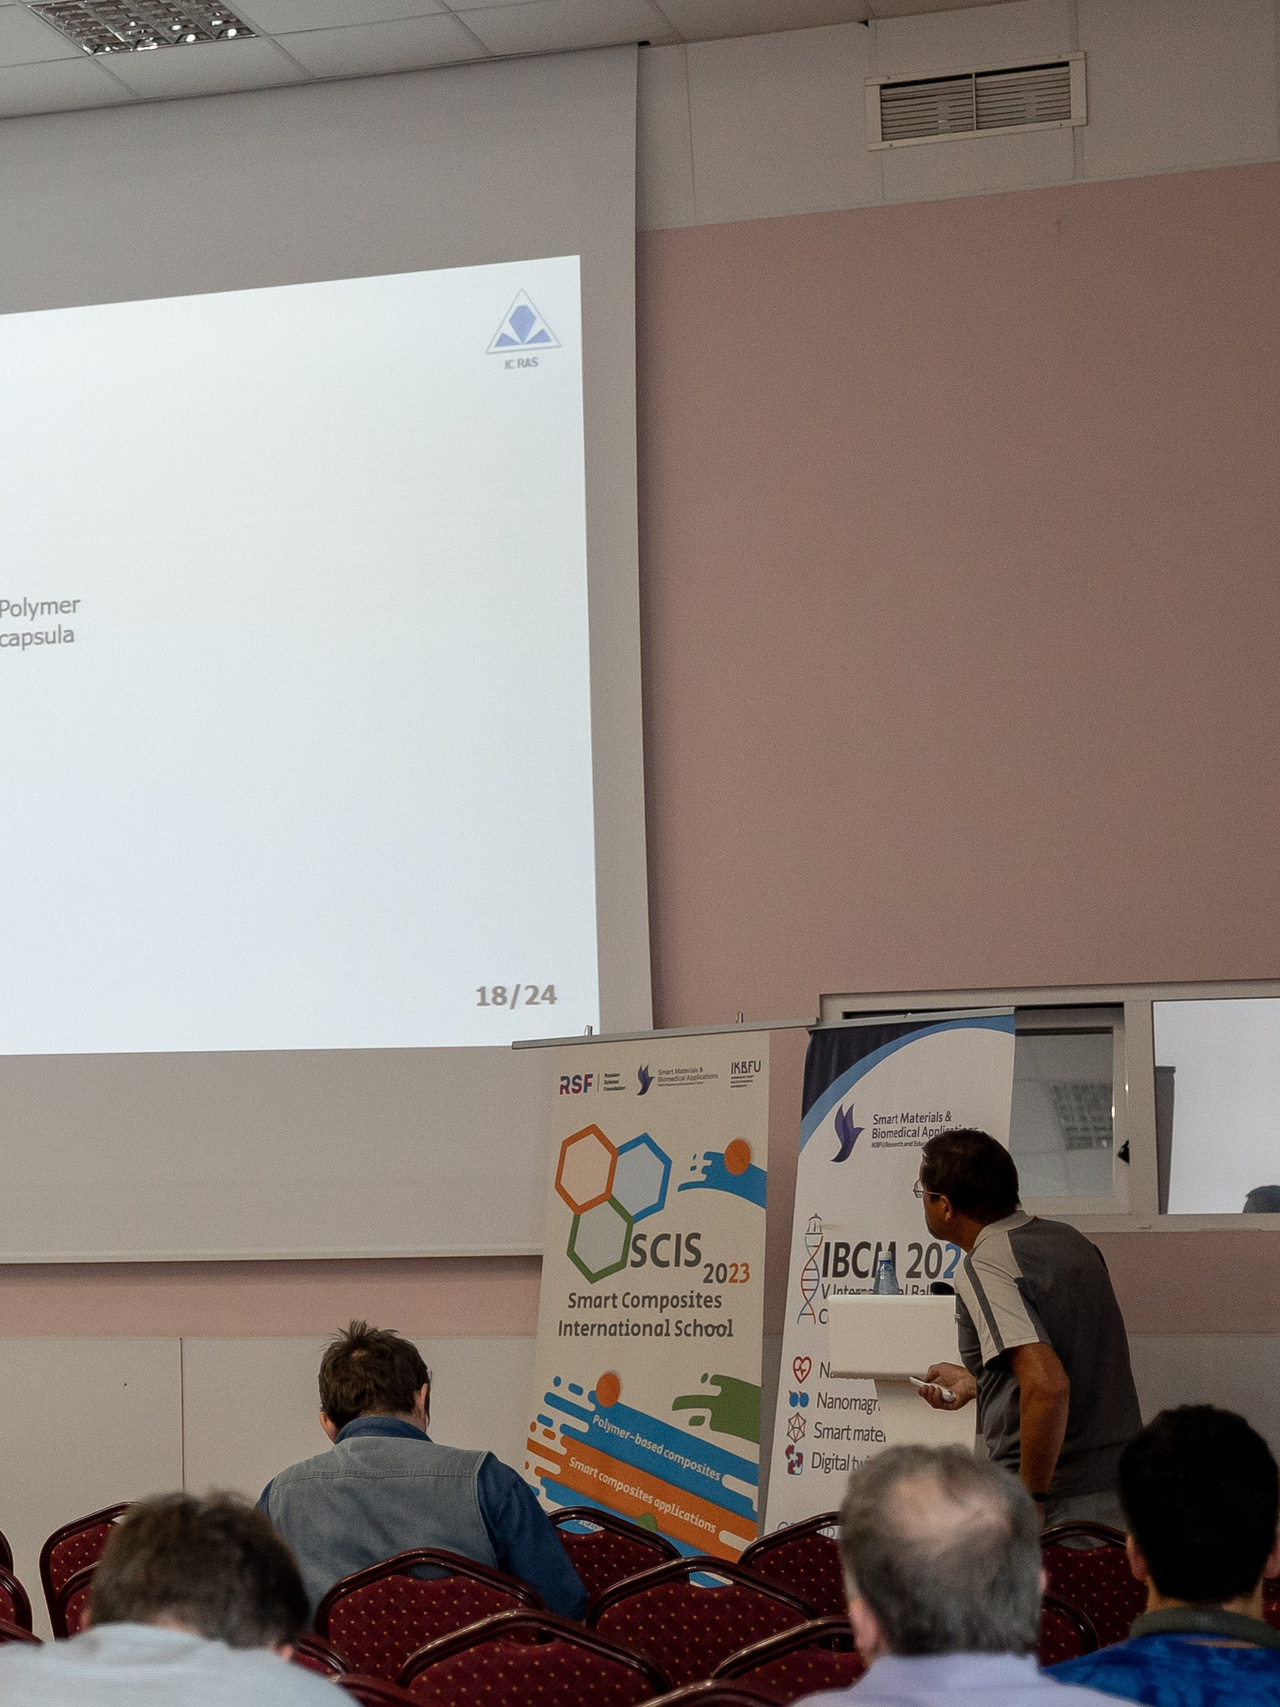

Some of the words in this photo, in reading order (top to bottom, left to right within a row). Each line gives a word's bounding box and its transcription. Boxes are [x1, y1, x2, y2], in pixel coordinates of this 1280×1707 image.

[517, 356, 539, 369] RAS
[476, 983, 558, 1010] 18/24
[730, 1060, 761, 1075] IKBFU
[560, 1073, 593, 1095] RSF
[872, 1114, 899, 1125] Smart
[900, 1111, 944, 1124] Materials
[944, 1110, 952, 1122] &
[871, 1126, 920, 1139] Biomedical
[630, 1232, 702, 1268] SCIS
[822, 1241, 897, 1279] IBCM
[905, 1242, 962, 1279] 202
[702, 1262, 751, 1284] 2023
[568, 1292, 618, 1309] Smart
[621, 1290, 722, 1313] Composites
[821, 1284, 831, 1300] V
[558, 1319, 671, 1337] International
[674, 1318, 734, 1337] School
[813, 1421, 851, 1441] Smart
[592, 1414, 664, 1455] Polymer-based
[663, 1449, 721, 1482] composites
[811, 1451, 850, 1475] Digital
[568, 1457, 599, 1479] Smart
[598, 1472, 654, 1504] composites
[654, 1498, 717, 1534] applications
